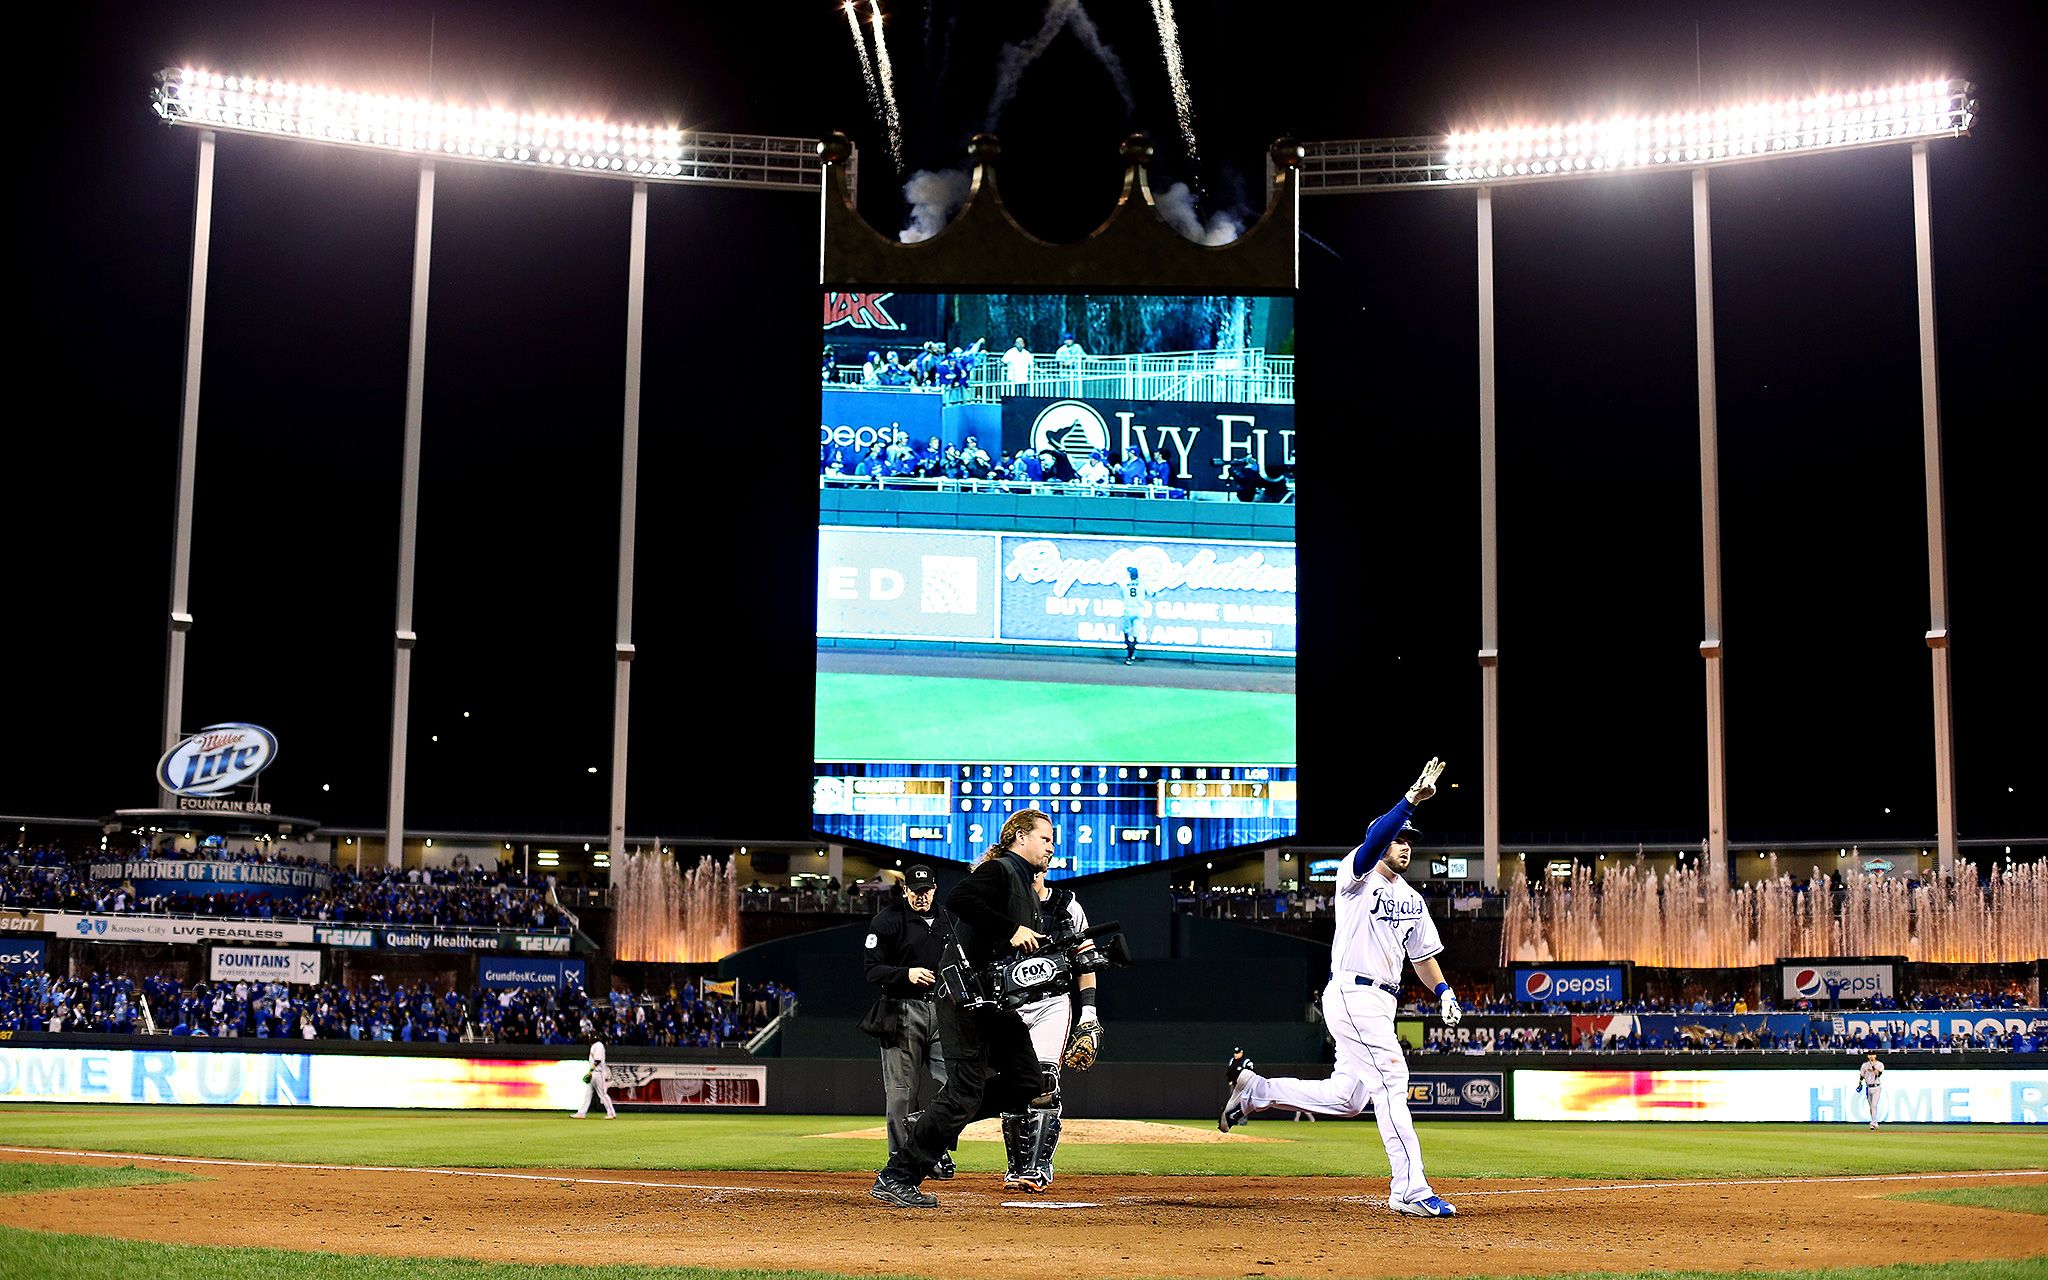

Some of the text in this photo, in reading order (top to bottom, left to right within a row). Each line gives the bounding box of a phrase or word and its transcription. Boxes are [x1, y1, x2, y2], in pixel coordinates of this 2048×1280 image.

[1094, 599, 1153, 618] USD
[195, 733, 246, 753] Miller
[181, 744, 260, 790] Lite
[962, 766, 971, 778] 1
[983, 766, 992, 778] 2
[1003, 766, 1013, 778] 3
[1029, 766, 1040, 778] 4
[1098, 767, 1108, 779] 7
[180, 798, 271, 815] FOUNTAIN BAR
[968, 824, 983, 843] 2
[1077, 825, 1093, 844] 2
[1176, 825, 1193, 845] 0
[90, 864, 122, 880] PROUD
[124, 862, 185, 880] PARTNER
[188, 863, 206, 880] OF
[211, 863, 239, 881] THE
[241, 865, 290, 885] KANSAS
[292, 869, 313, 887] CITY
[1369, 887, 1423, 928] Royals
[10, 918, 39, 931] CITY
[111, 924, 283, 939] Kansas City LIVE FEARLESS
[316, 929, 570, 951] TEVA Quality Healthcare TEVA
[218, 953, 291, 968] FOUNTAINS
[485, 969, 556, 983] GrundfosKC.com
[1022, 962, 1047, 978] FOX
[1023, 972, 1050, 983] SPORTS
[1556, 974, 1611, 995] pepsi
[1826, 974, 1881, 994] pepsi
[1429, 1027, 1470, 1044] H&R
[130, 1049, 312, 1105] RUN
[1435, 1081, 1448, 1096] 10
[1470, 1084, 1490, 1094] FOX
[1437, 1096, 1461, 1106] NIGHTLY
[1809, 1087, 1971, 1122] HOME
